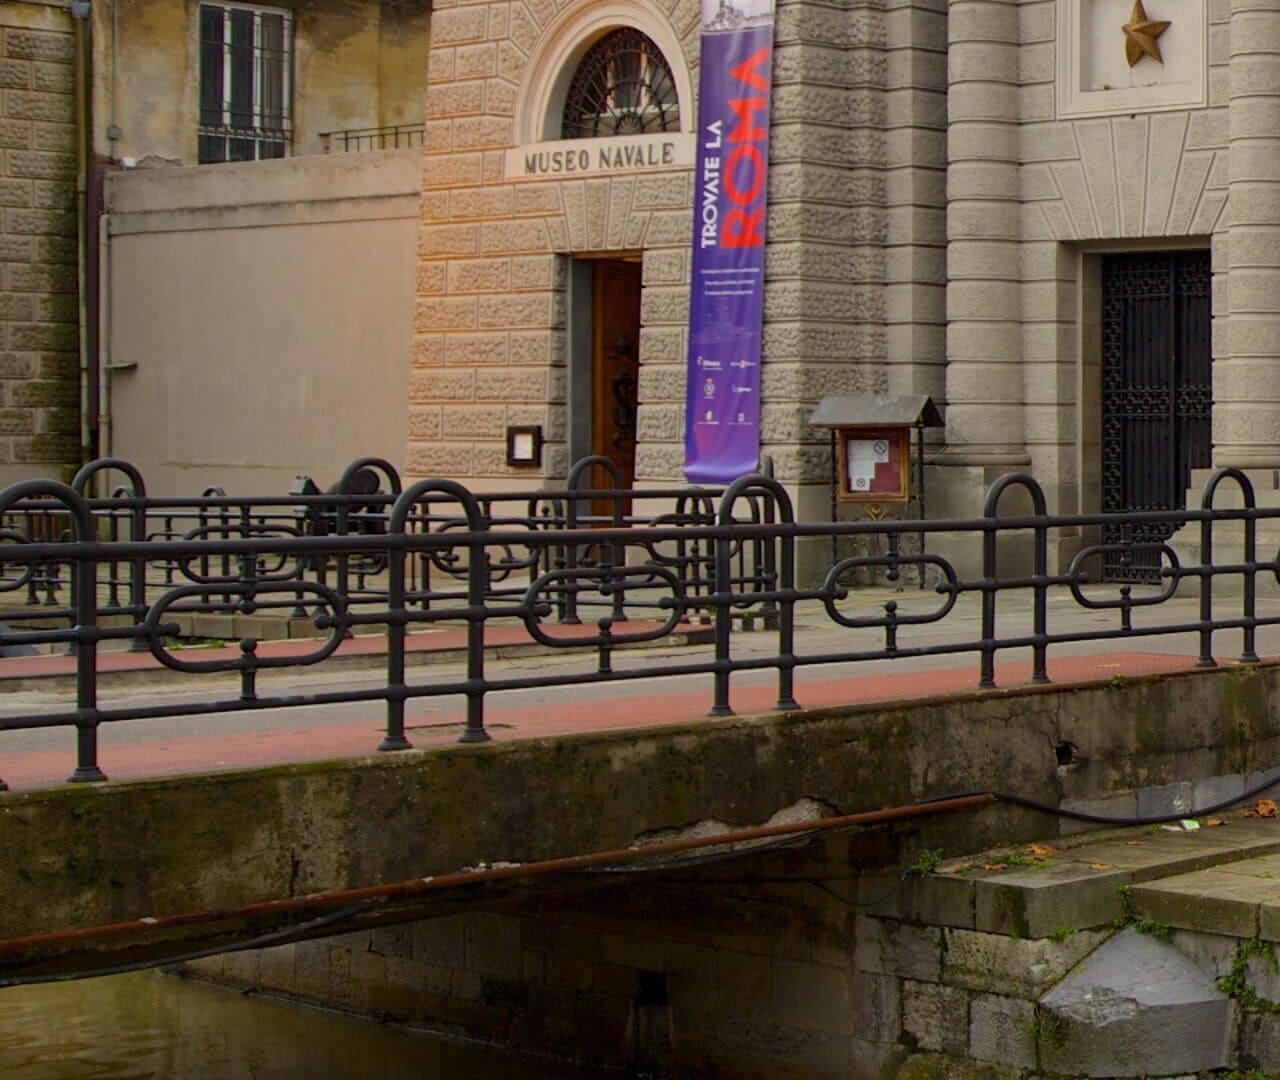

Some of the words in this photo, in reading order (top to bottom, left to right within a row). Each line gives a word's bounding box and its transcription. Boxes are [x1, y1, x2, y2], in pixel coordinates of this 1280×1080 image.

[525, 150, 589, 174] MUSEO
[600, 143, 674, 169] NAVALE
[705, 120, 722, 149] LA
[720, 46, 769, 248] ROMA
[701, 157, 720, 248] TROVATE
